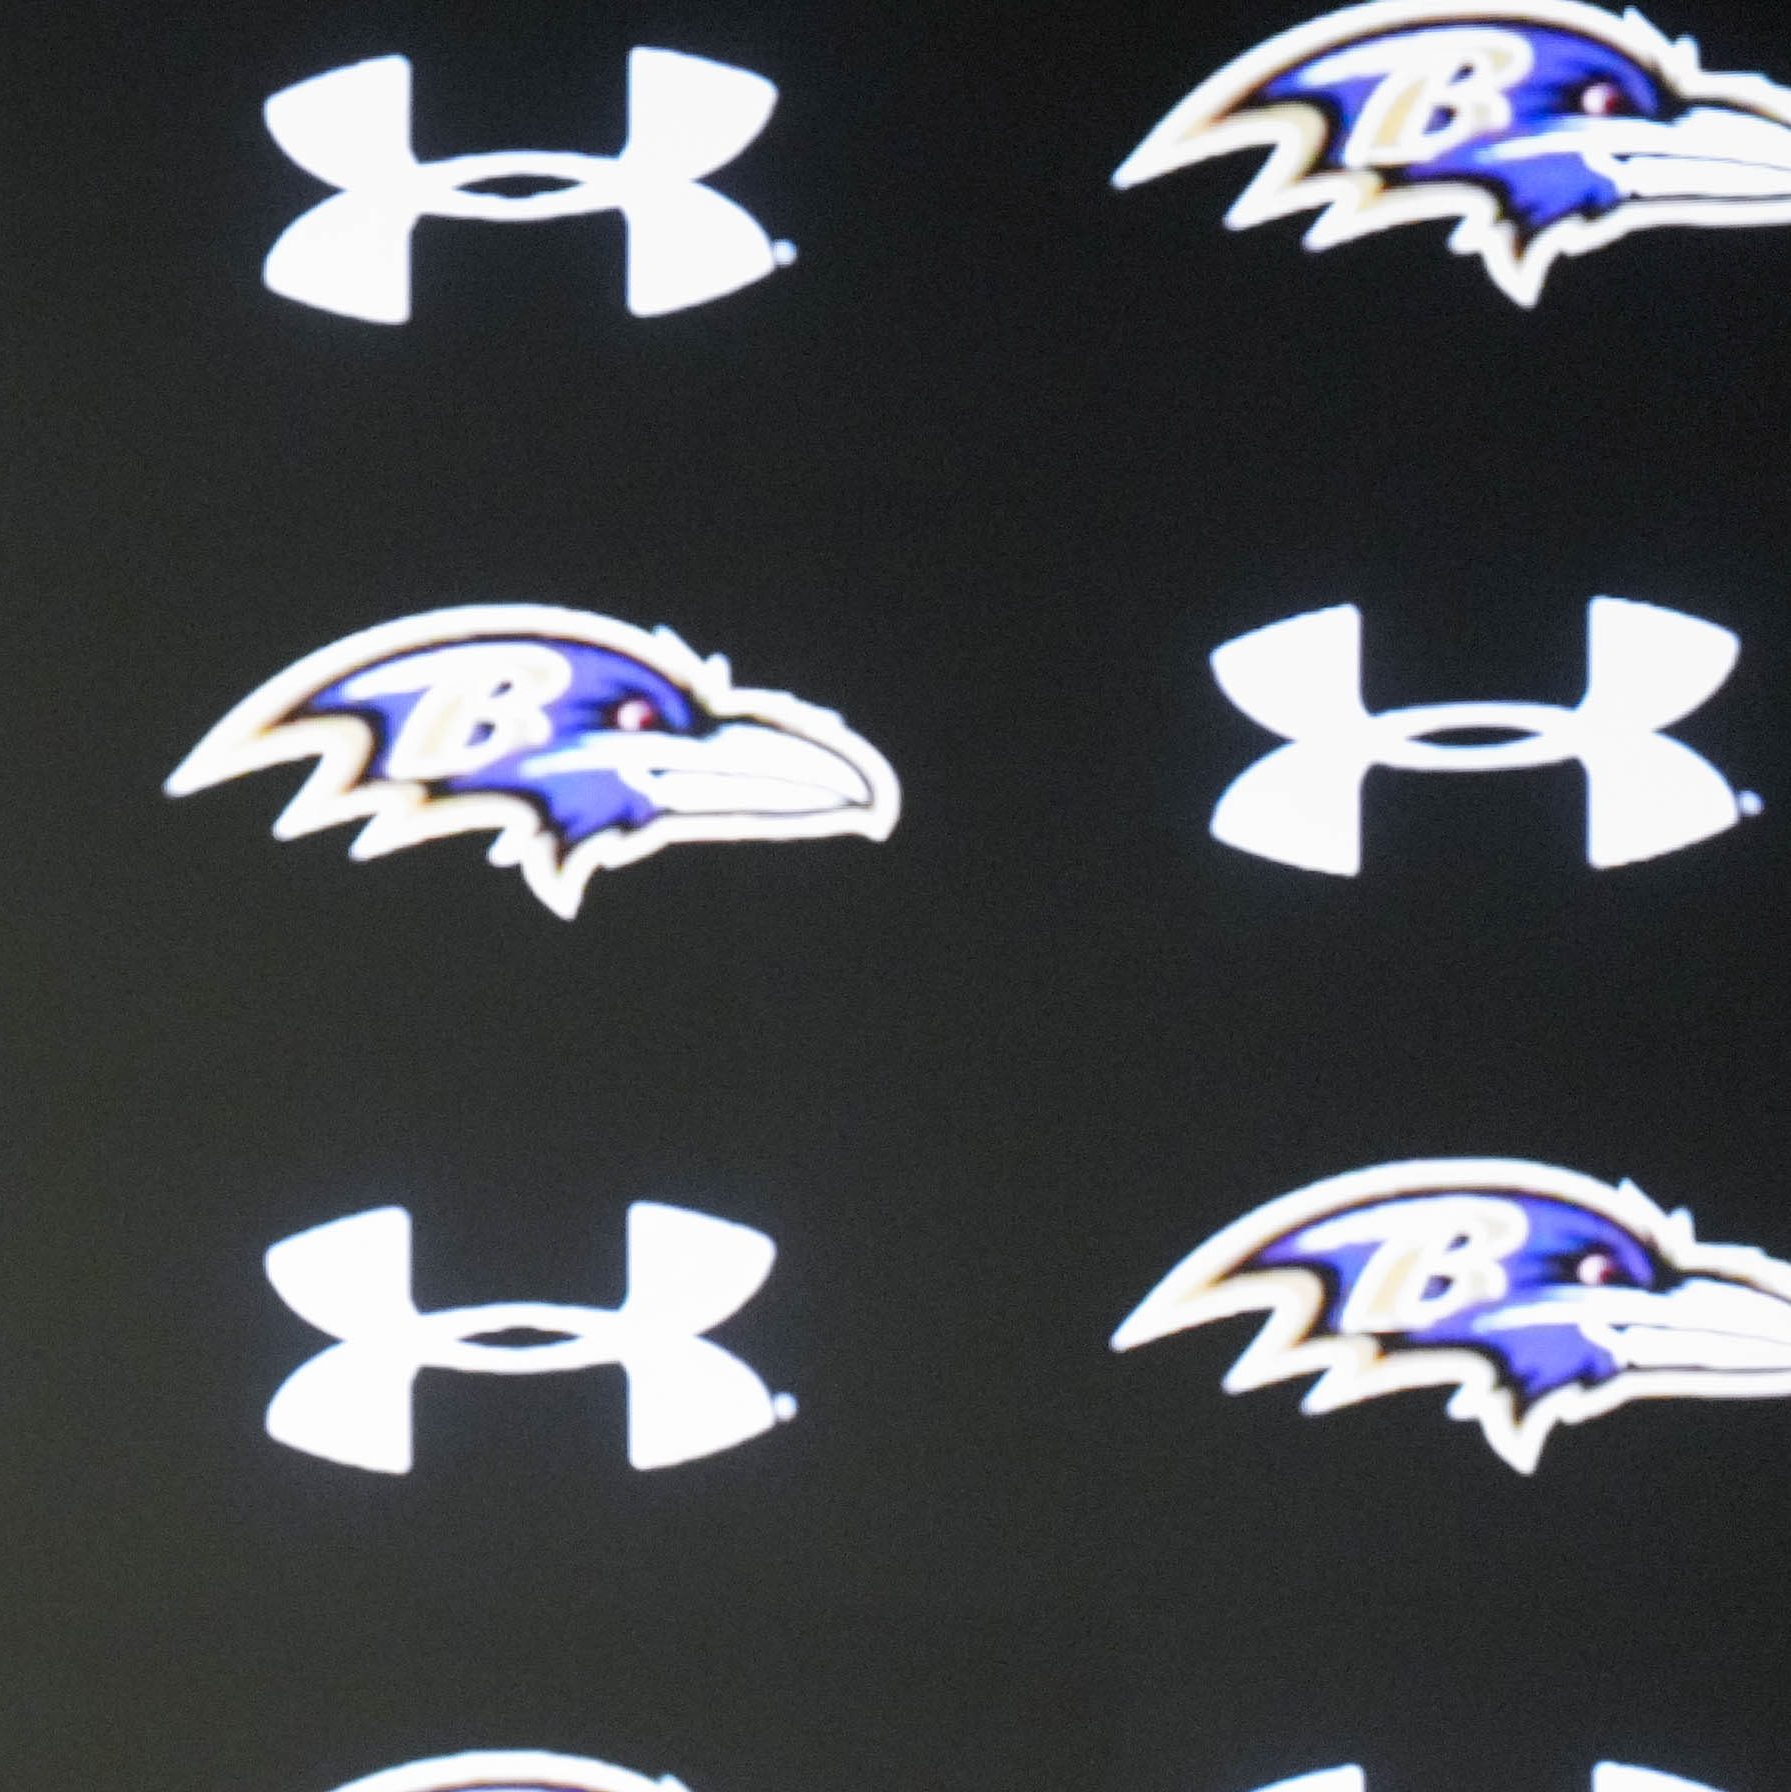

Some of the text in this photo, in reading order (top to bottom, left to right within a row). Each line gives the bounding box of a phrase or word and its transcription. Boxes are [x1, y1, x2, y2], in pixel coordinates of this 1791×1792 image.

[1299, 28, 1532, 166] B
[344, 641, 571, 778] B
[1297, 1193, 1527, 1332] B
